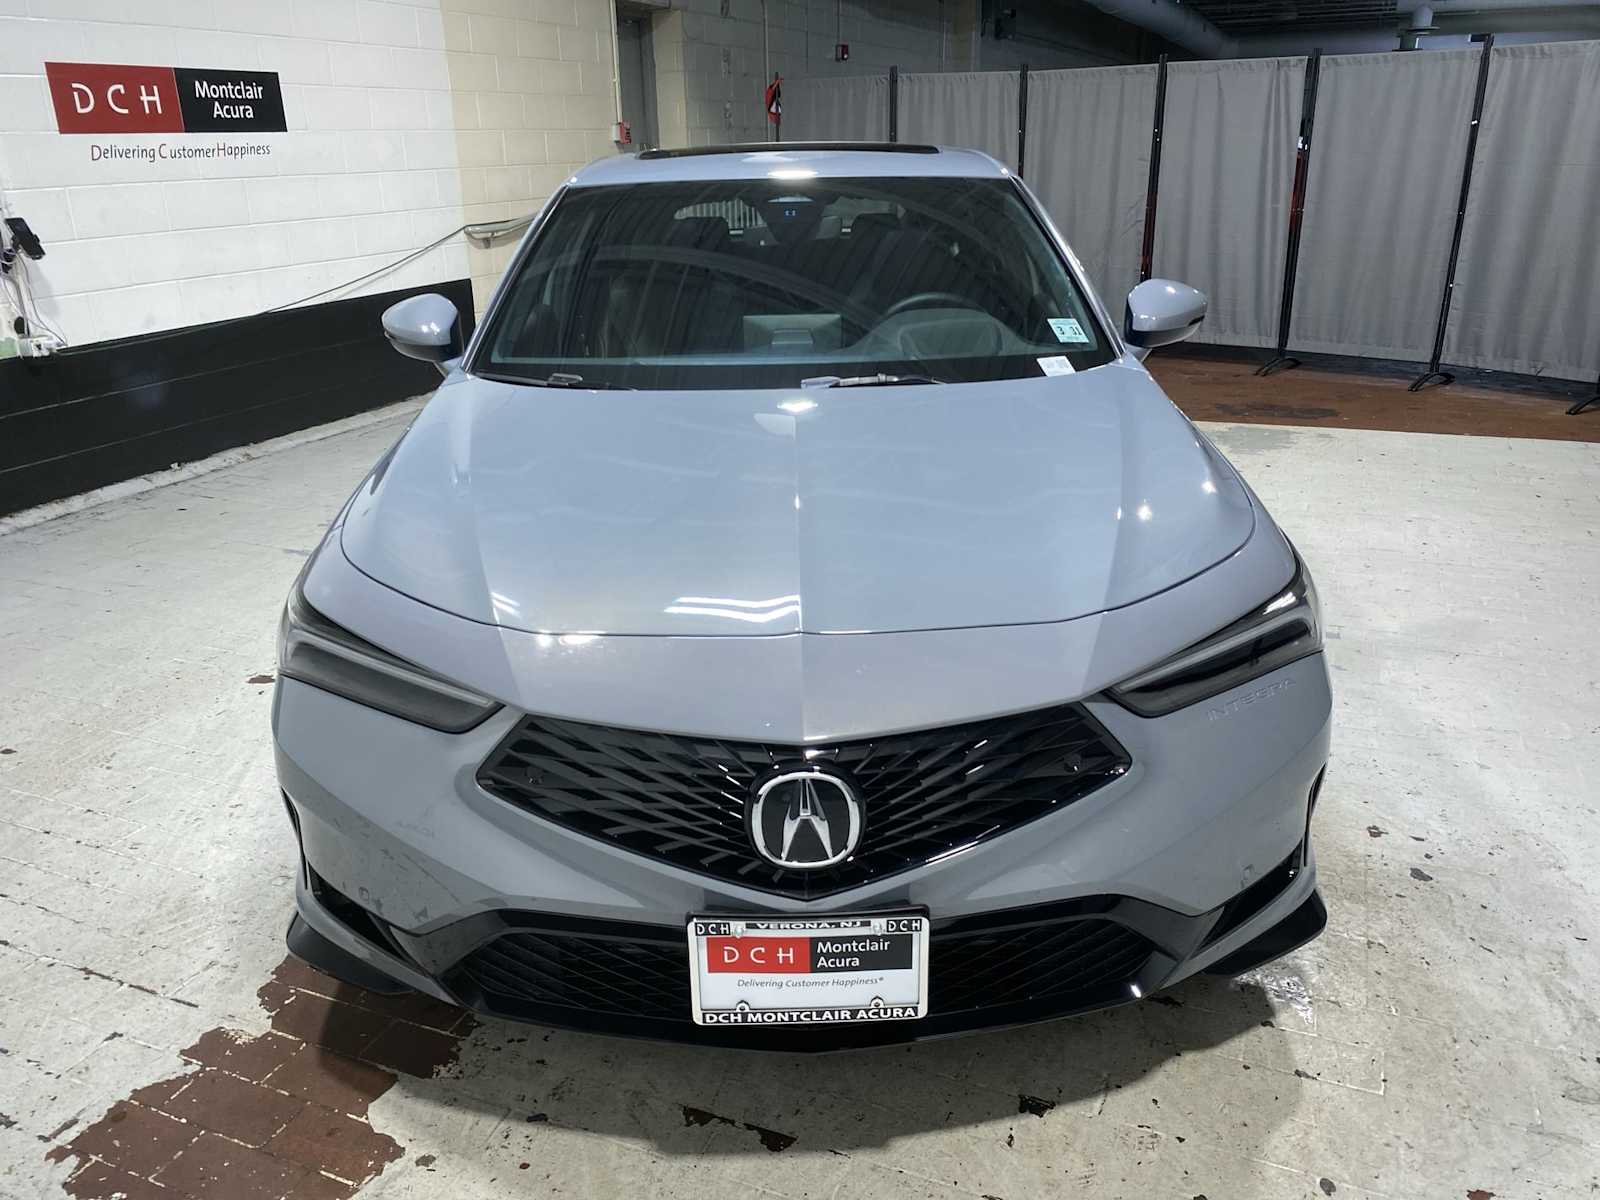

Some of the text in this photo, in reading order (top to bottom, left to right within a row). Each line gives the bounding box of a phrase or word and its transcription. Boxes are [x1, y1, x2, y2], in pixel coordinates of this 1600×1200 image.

[194, 80, 263, 100] Montclair
[212, 101, 254, 119] Acura
[91, 142, 271, 163] Delivering Customer Happiness
[696, 922, 730, 936] DCH
[839, 920, 862, 929] NJ
[887, 919, 922, 932] DCH
[817, 938, 890, 954] Montclair
[723, 945, 794, 965] DCH
[816, 955, 860, 969] Acura
[737, 978, 784, 990] Delivering
[785, 977, 830, 988] Customer
[705, 1006, 916, 1024] DCH MONTCLAIR ACURA
